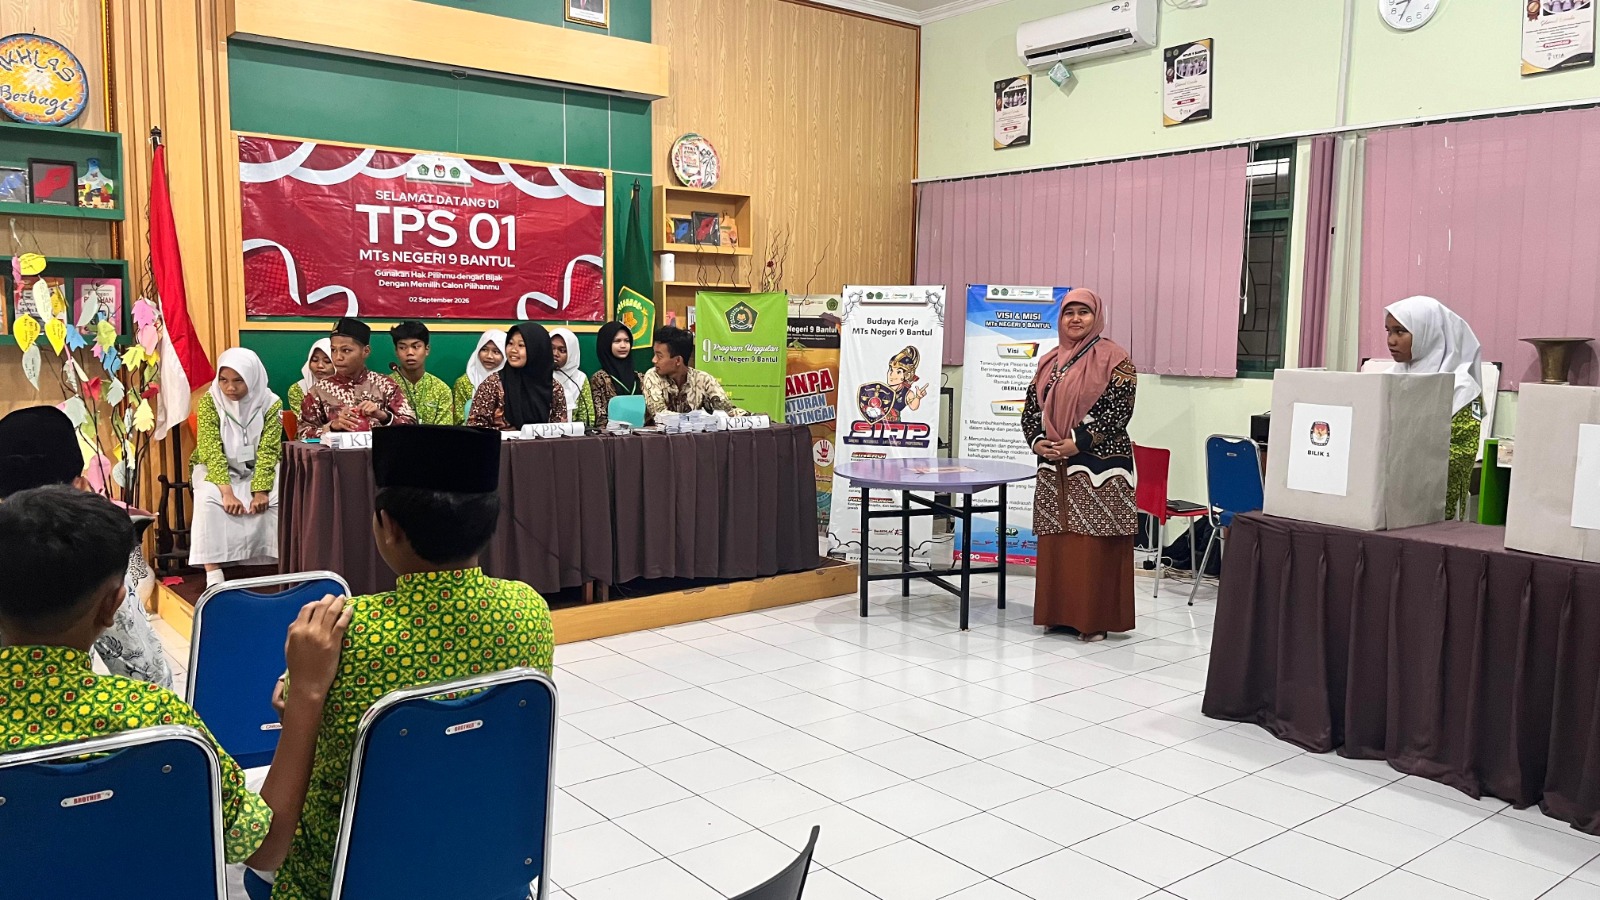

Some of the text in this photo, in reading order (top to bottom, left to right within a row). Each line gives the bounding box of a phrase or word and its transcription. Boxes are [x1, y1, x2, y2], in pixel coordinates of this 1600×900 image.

[0, 84, 73, 115] Berbagi
[376, 190, 499, 209] SELAMAT DATANG DI
[356, 204, 516, 251] TPS 01
[359, 249, 515, 268] MTs NEGERI 9 BANTUL
[374, 270, 410, 278] Gunakan
[412, 271, 426, 279] Hak
[456, 273, 484, 281] dengan
[485, 274, 503, 282] Bijak
[379, 280, 409, 289] Dengan
[464, 282, 499, 290] Pilihanmu
[418, 296, 453, 304] September
[867, 317, 918, 327] Budaya Kerja
[1015, 312, 1020, 320] &
[787, 326, 808, 334] Negeri
[871, 328, 897, 337] Negeri
[703, 339, 779, 363] 9 Program Unggulan
[786, 370, 834, 396] ANPA
[785, 394, 826, 412] NTURAN
[726, 417, 762, 428] KPPS 3
[532, 424, 565, 436] KPPS
[852, 421, 930, 439] SIAP
